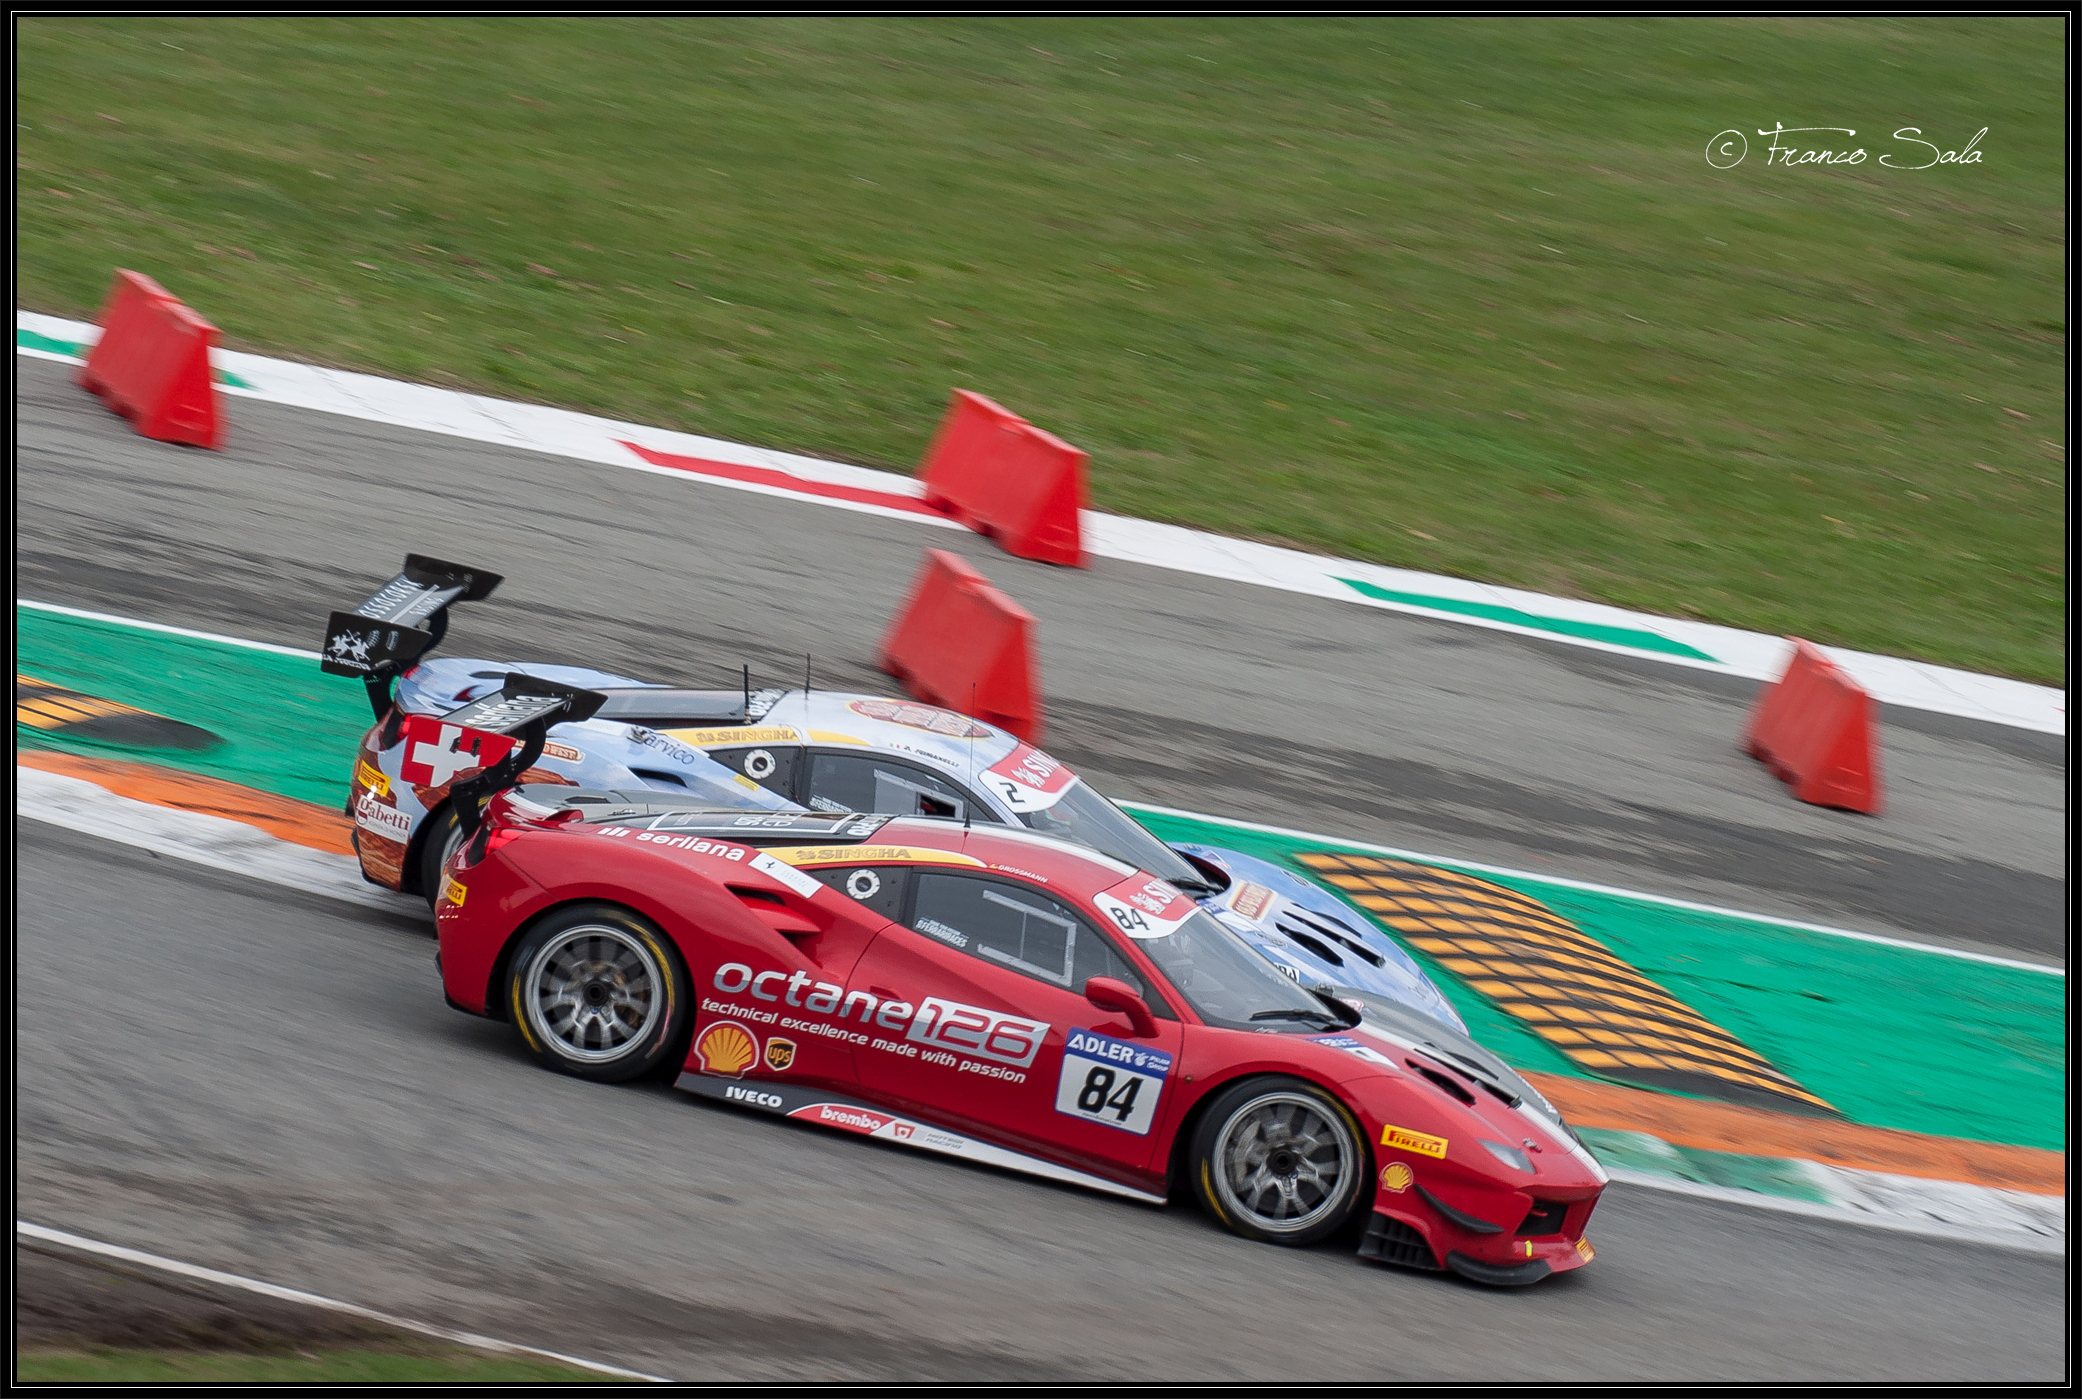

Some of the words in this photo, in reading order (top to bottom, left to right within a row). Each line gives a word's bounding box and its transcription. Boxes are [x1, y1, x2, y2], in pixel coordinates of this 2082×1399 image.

[643, 730, 695, 765] arvico
[998, 781, 1027, 804] 2
[356, 799, 410, 831] gabetti
[635, 831, 746, 862] serliana
[817, 847, 912, 860] SINGHA
[1109, 907, 1151, 931] 84
[701, 997, 778, 1025] technical
[779, 1017, 869, 1046] excellence
[870, 1037, 918, 1058] made
[920, 1049, 957, 1068] with
[957, 1059, 1027, 1084] passion
[1066, 1033, 1135, 1064] ADLER
[768, 1046, 792, 1065] ups
[725, 1086, 783, 1108] IVECO
[1077, 1065, 1145, 1123] 84
[819, 1105, 882, 1130] brembo
[1388, 1129, 1443, 1154] PIRELLI
